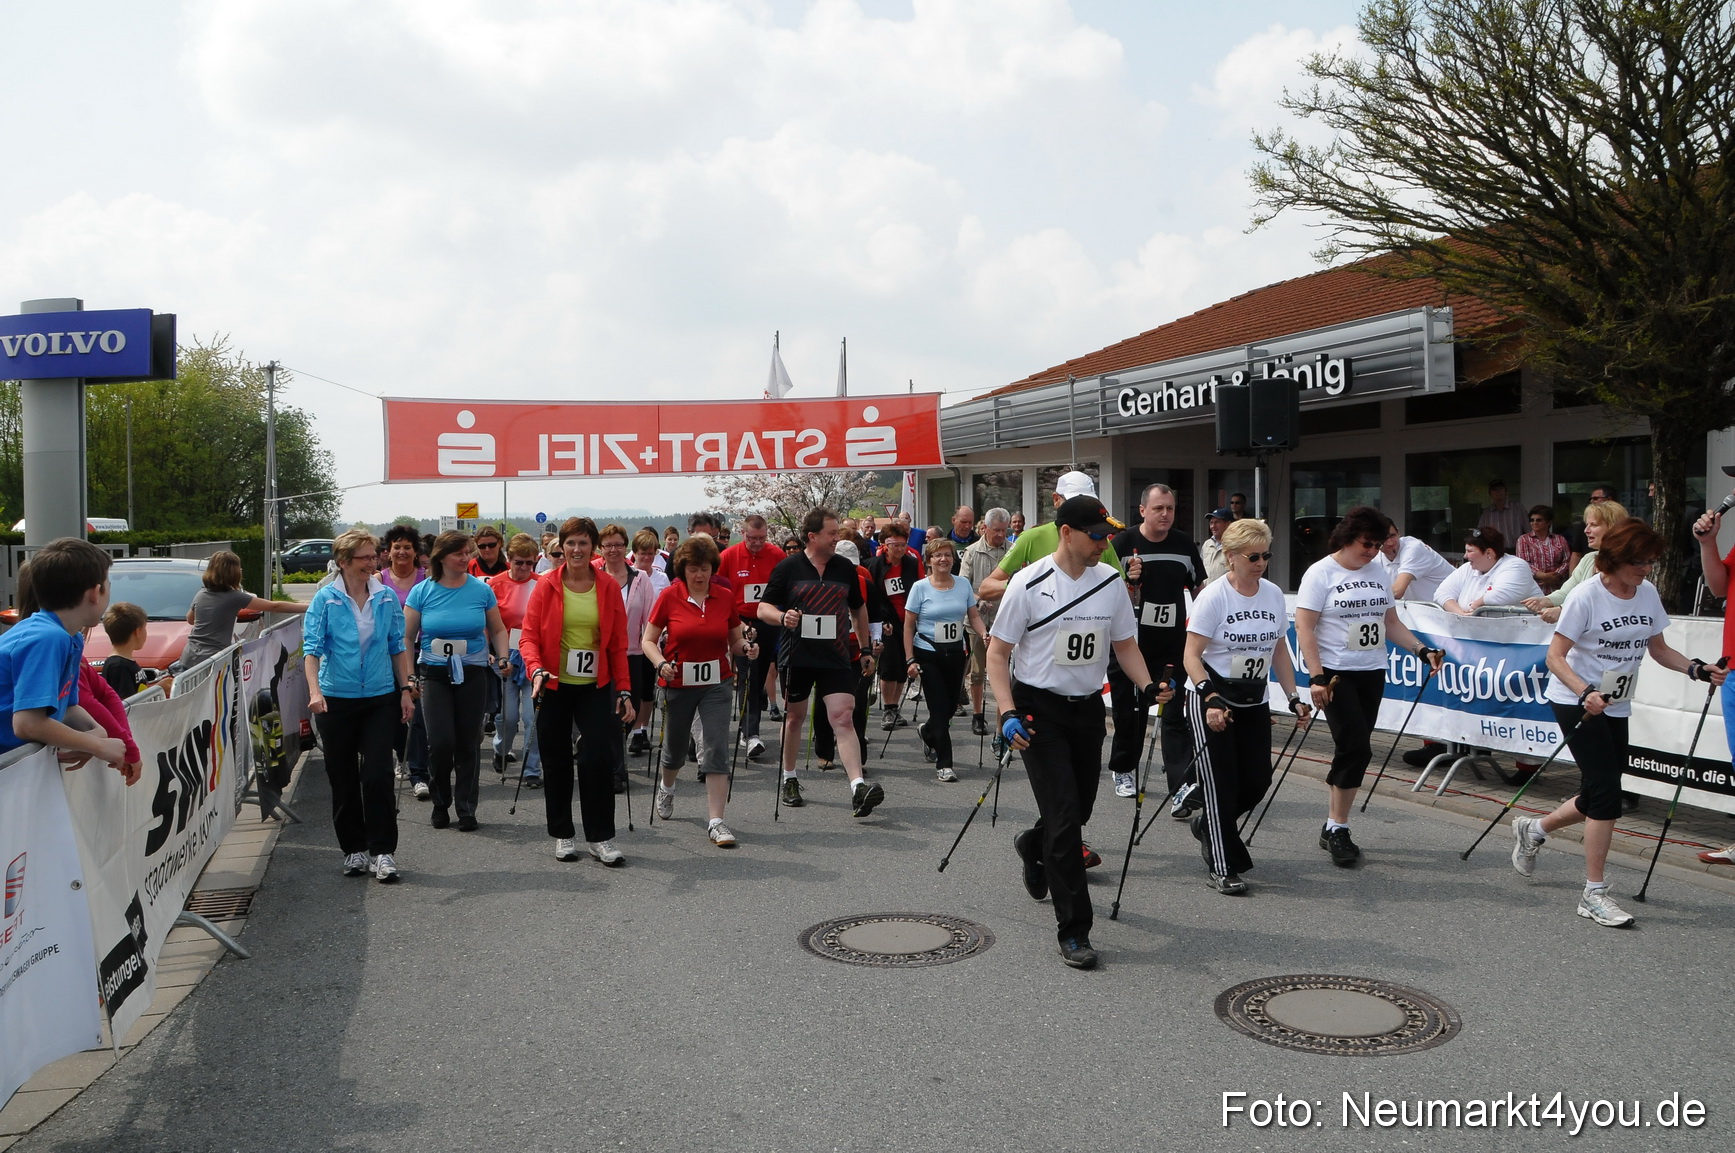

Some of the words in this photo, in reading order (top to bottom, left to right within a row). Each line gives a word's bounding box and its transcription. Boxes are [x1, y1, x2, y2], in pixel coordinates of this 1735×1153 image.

[0, 330, 127, 357] VOLVO
[1117, 375, 1218, 417] Gerhart
[1336, 581, 1385, 594] BERGER
[1334, 600, 1367, 609] POWER
[1370, 597, 1389, 607] GIRL
[1153, 604, 1170, 625] 15
[1226, 610, 1276, 625] BERGER
[815, 617, 822, 636] 1
[942, 622, 958, 639] 16
[1359, 623, 1379, 647] 33
[1067, 632, 1095, 661] 96
[1223, 631, 1257, 643] POWER
[1598, 638, 1631, 650] POWER
[443, 642, 454, 657] 9
[1597, 653, 1622, 663] walking
[576, 652, 595, 674] 12
[1242, 658, 1265, 679] 32
[692, 663, 712, 683] 10
[1611, 673, 1634, 700] 31
[1481, 720, 1516, 739] Hier
[1702, 770, 1726, 785] die
[30, 943, 60, 965] GRUPPE
